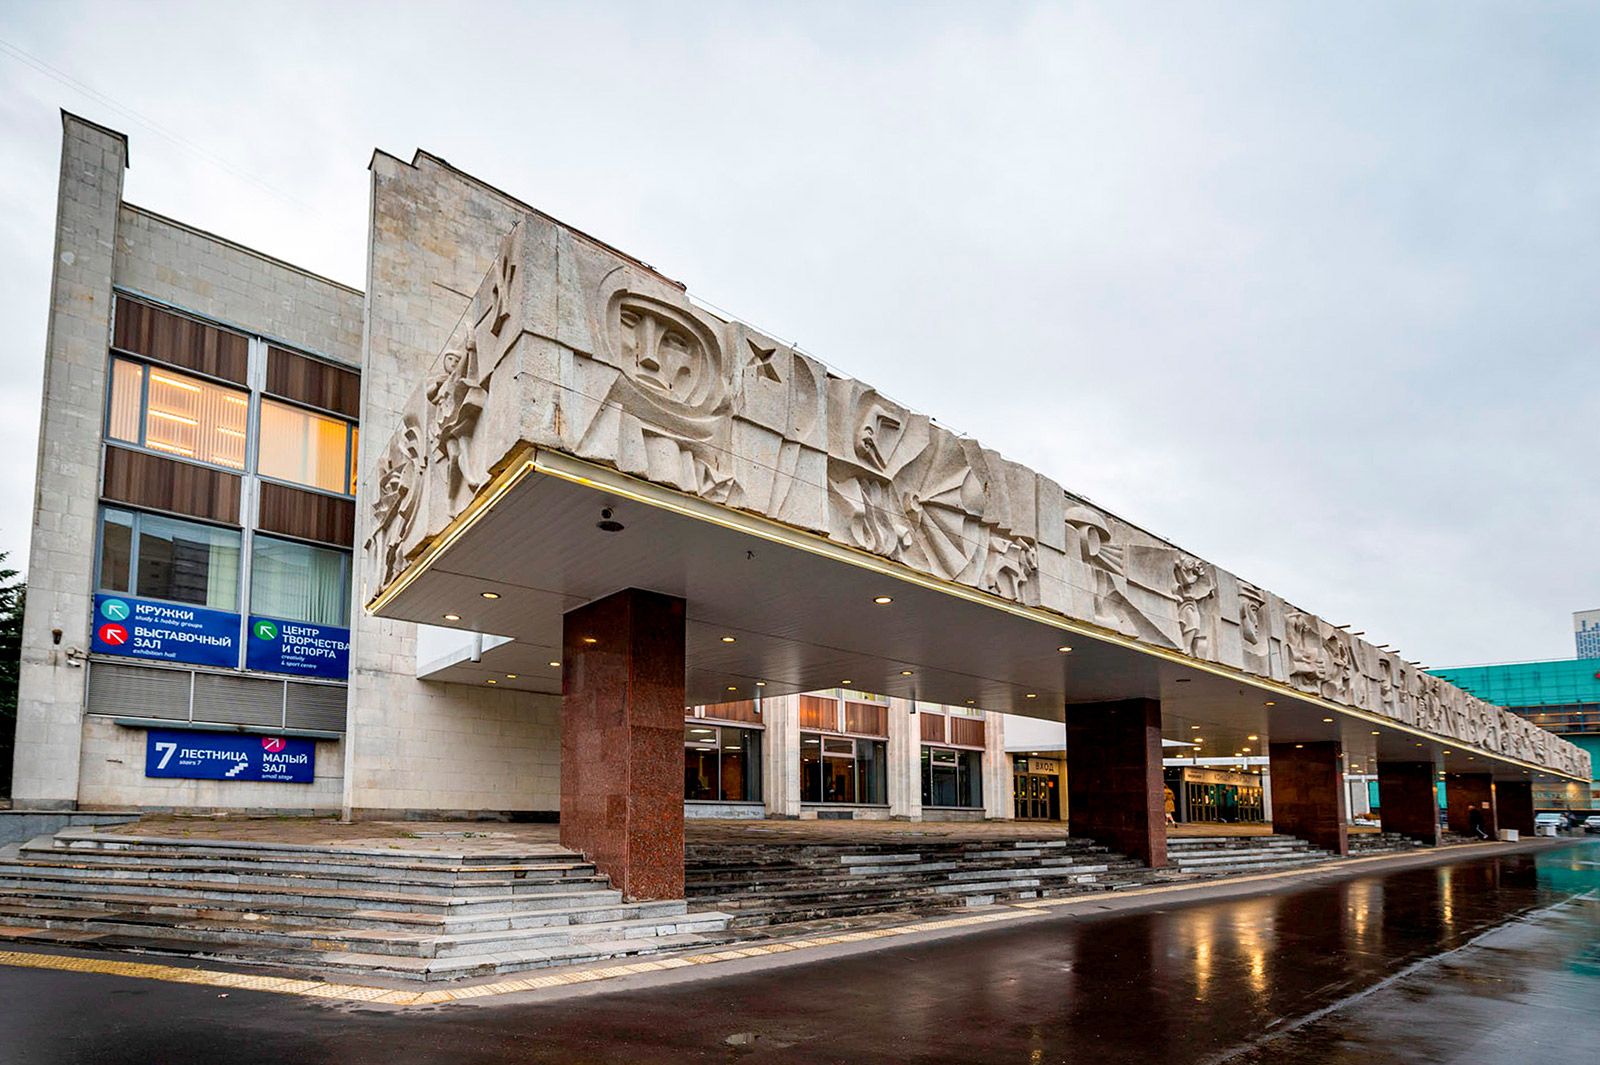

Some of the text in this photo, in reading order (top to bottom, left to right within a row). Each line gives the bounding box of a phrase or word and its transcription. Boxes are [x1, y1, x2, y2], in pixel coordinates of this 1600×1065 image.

[136, 605, 194, 620] КРУЖКИ
[160, 618, 180, 626] hobby
[134, 626, 232, 647] ВЫСТАВОЧНЫЙ
[283, 625, 319, 637] ЦЕНТР
[133, 637, 161, 649] ЗАЛ
[282, 634, 350, 650] ТВОРЧЕСТВА
[282, 644, 336, 658] И СПОРТА
[155, 741, 177, 770] 7
[179, 748, 248, 762] ЛЕСТНИЦА
[263, 753, 307, 764] МАЛЫЙ
[262, 763, 286, 773] ЗАЛ
[1036, 761, 1054, 772] ВХОД
